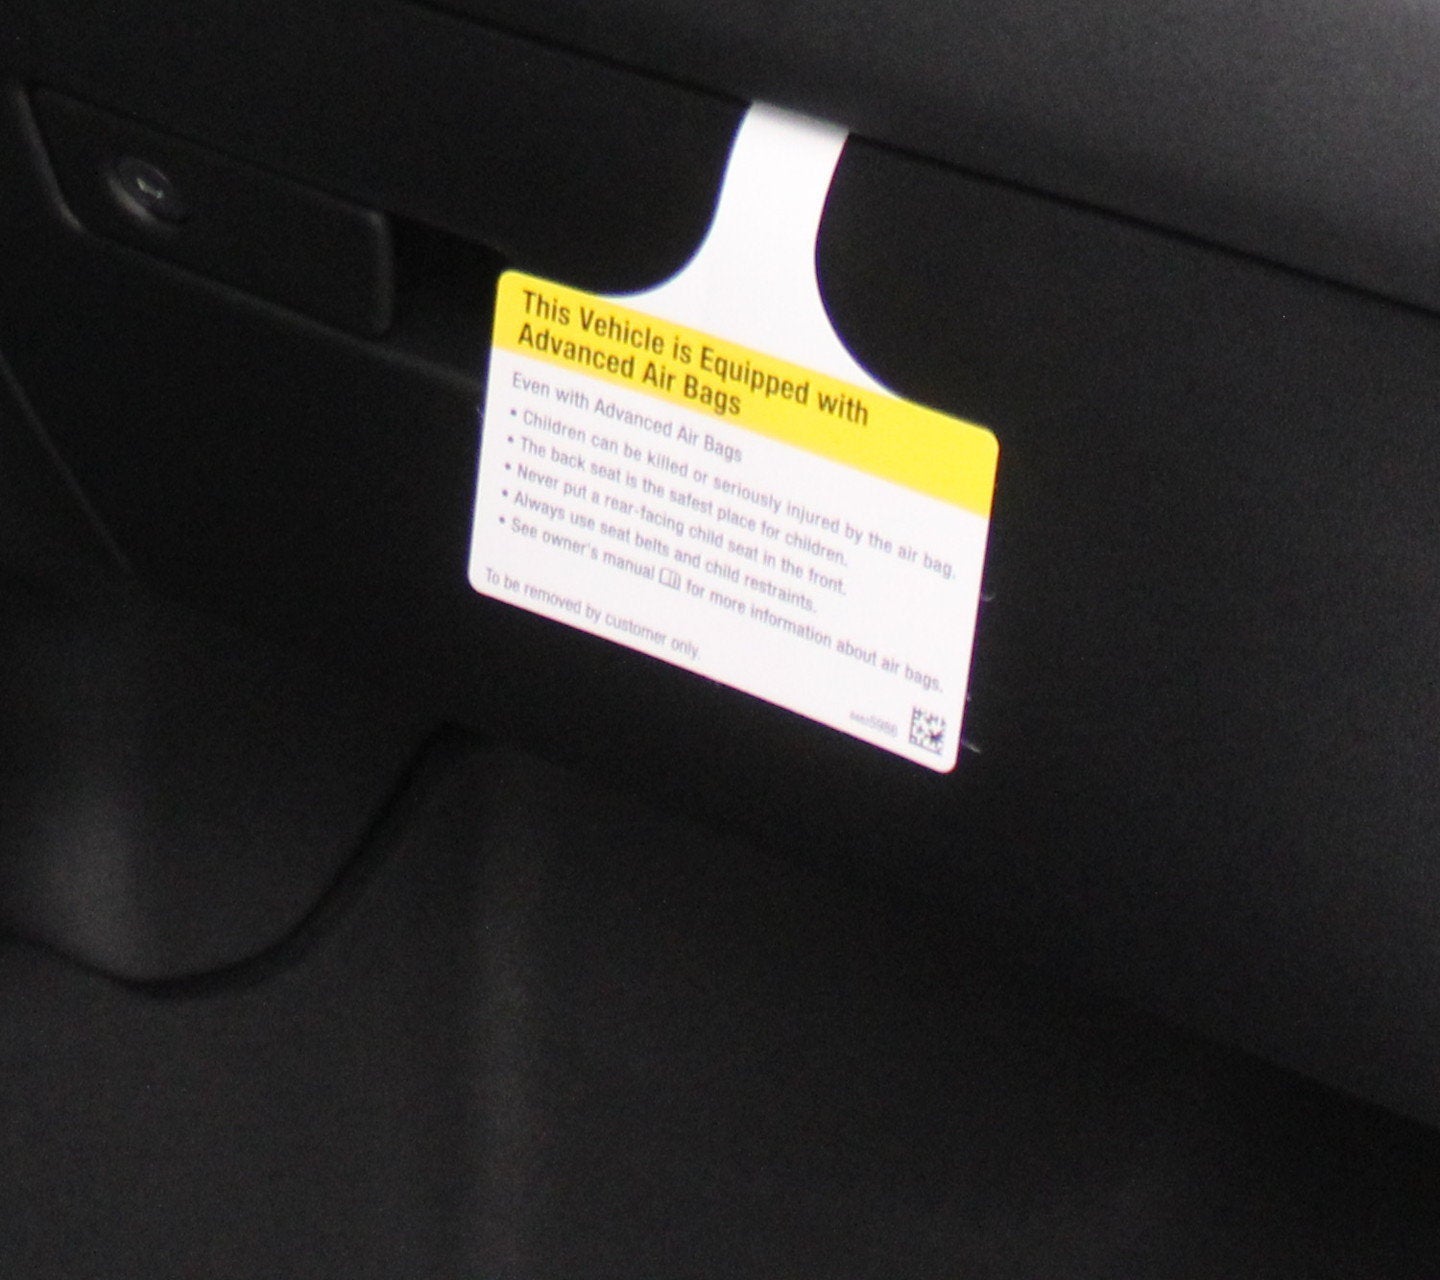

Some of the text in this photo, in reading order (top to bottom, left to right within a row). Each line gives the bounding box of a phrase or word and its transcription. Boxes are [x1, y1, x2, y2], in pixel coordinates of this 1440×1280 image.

[512, 370, 743, 464] Even with Advanced Air Bags
[518, 322, 740, 415] Advanced Air Bags
[523, 290, 868, 426] This Vehicle is Equipped with
[512, 489, 566, 522] Always
[569, 512, 596, 532] use
[600, 522, 631, 545] seat
[634, 530, 670, 558] belts
[673, 548, 702, 570] and
[704, 560, 741, 584] child
[516, 462, 559, 491] Never
[562, 482, 588, 501] put
[590, 490, 601, 506] a
[604, 494, 685, 538] rear-facing
[688, 525, 725, 549] child
[727, 539, 759, 563] seat
[762, 550, 777, 570] in
[780, 557, 804, 580] the
[520, 435, 848, 567] The back seat is the safest place for children.
[522, 408, 587, 444] Children
[590, 434, 619, 455] can
[622, 441, 643, 463] be
[646, 449, 689, 479] killed
[692, 469, 709, 485] or
[712, 476, 782, 515] seriously
[786, 500, 841, 535] injured
[844, 522, 864, 546] by
[868, 531, 893, 554] the
[897, 545, 919, 563] air
[485, 566, 501, 587] To
[502, 573, 521, 594] be
[523, 583, 583, 616] removed
[584, 602, 602, 626] by
[604, 613, 668, 647] customer
[510, 516, 538, 539] See
[602, 551, 656, 581] manual
[686, 578, 706, 599] for
[709, 590, 747, 616] more
[750, 603, 833, 649] information
[836, 640, 878, 667] about
[881, 658, 901, 675] air
